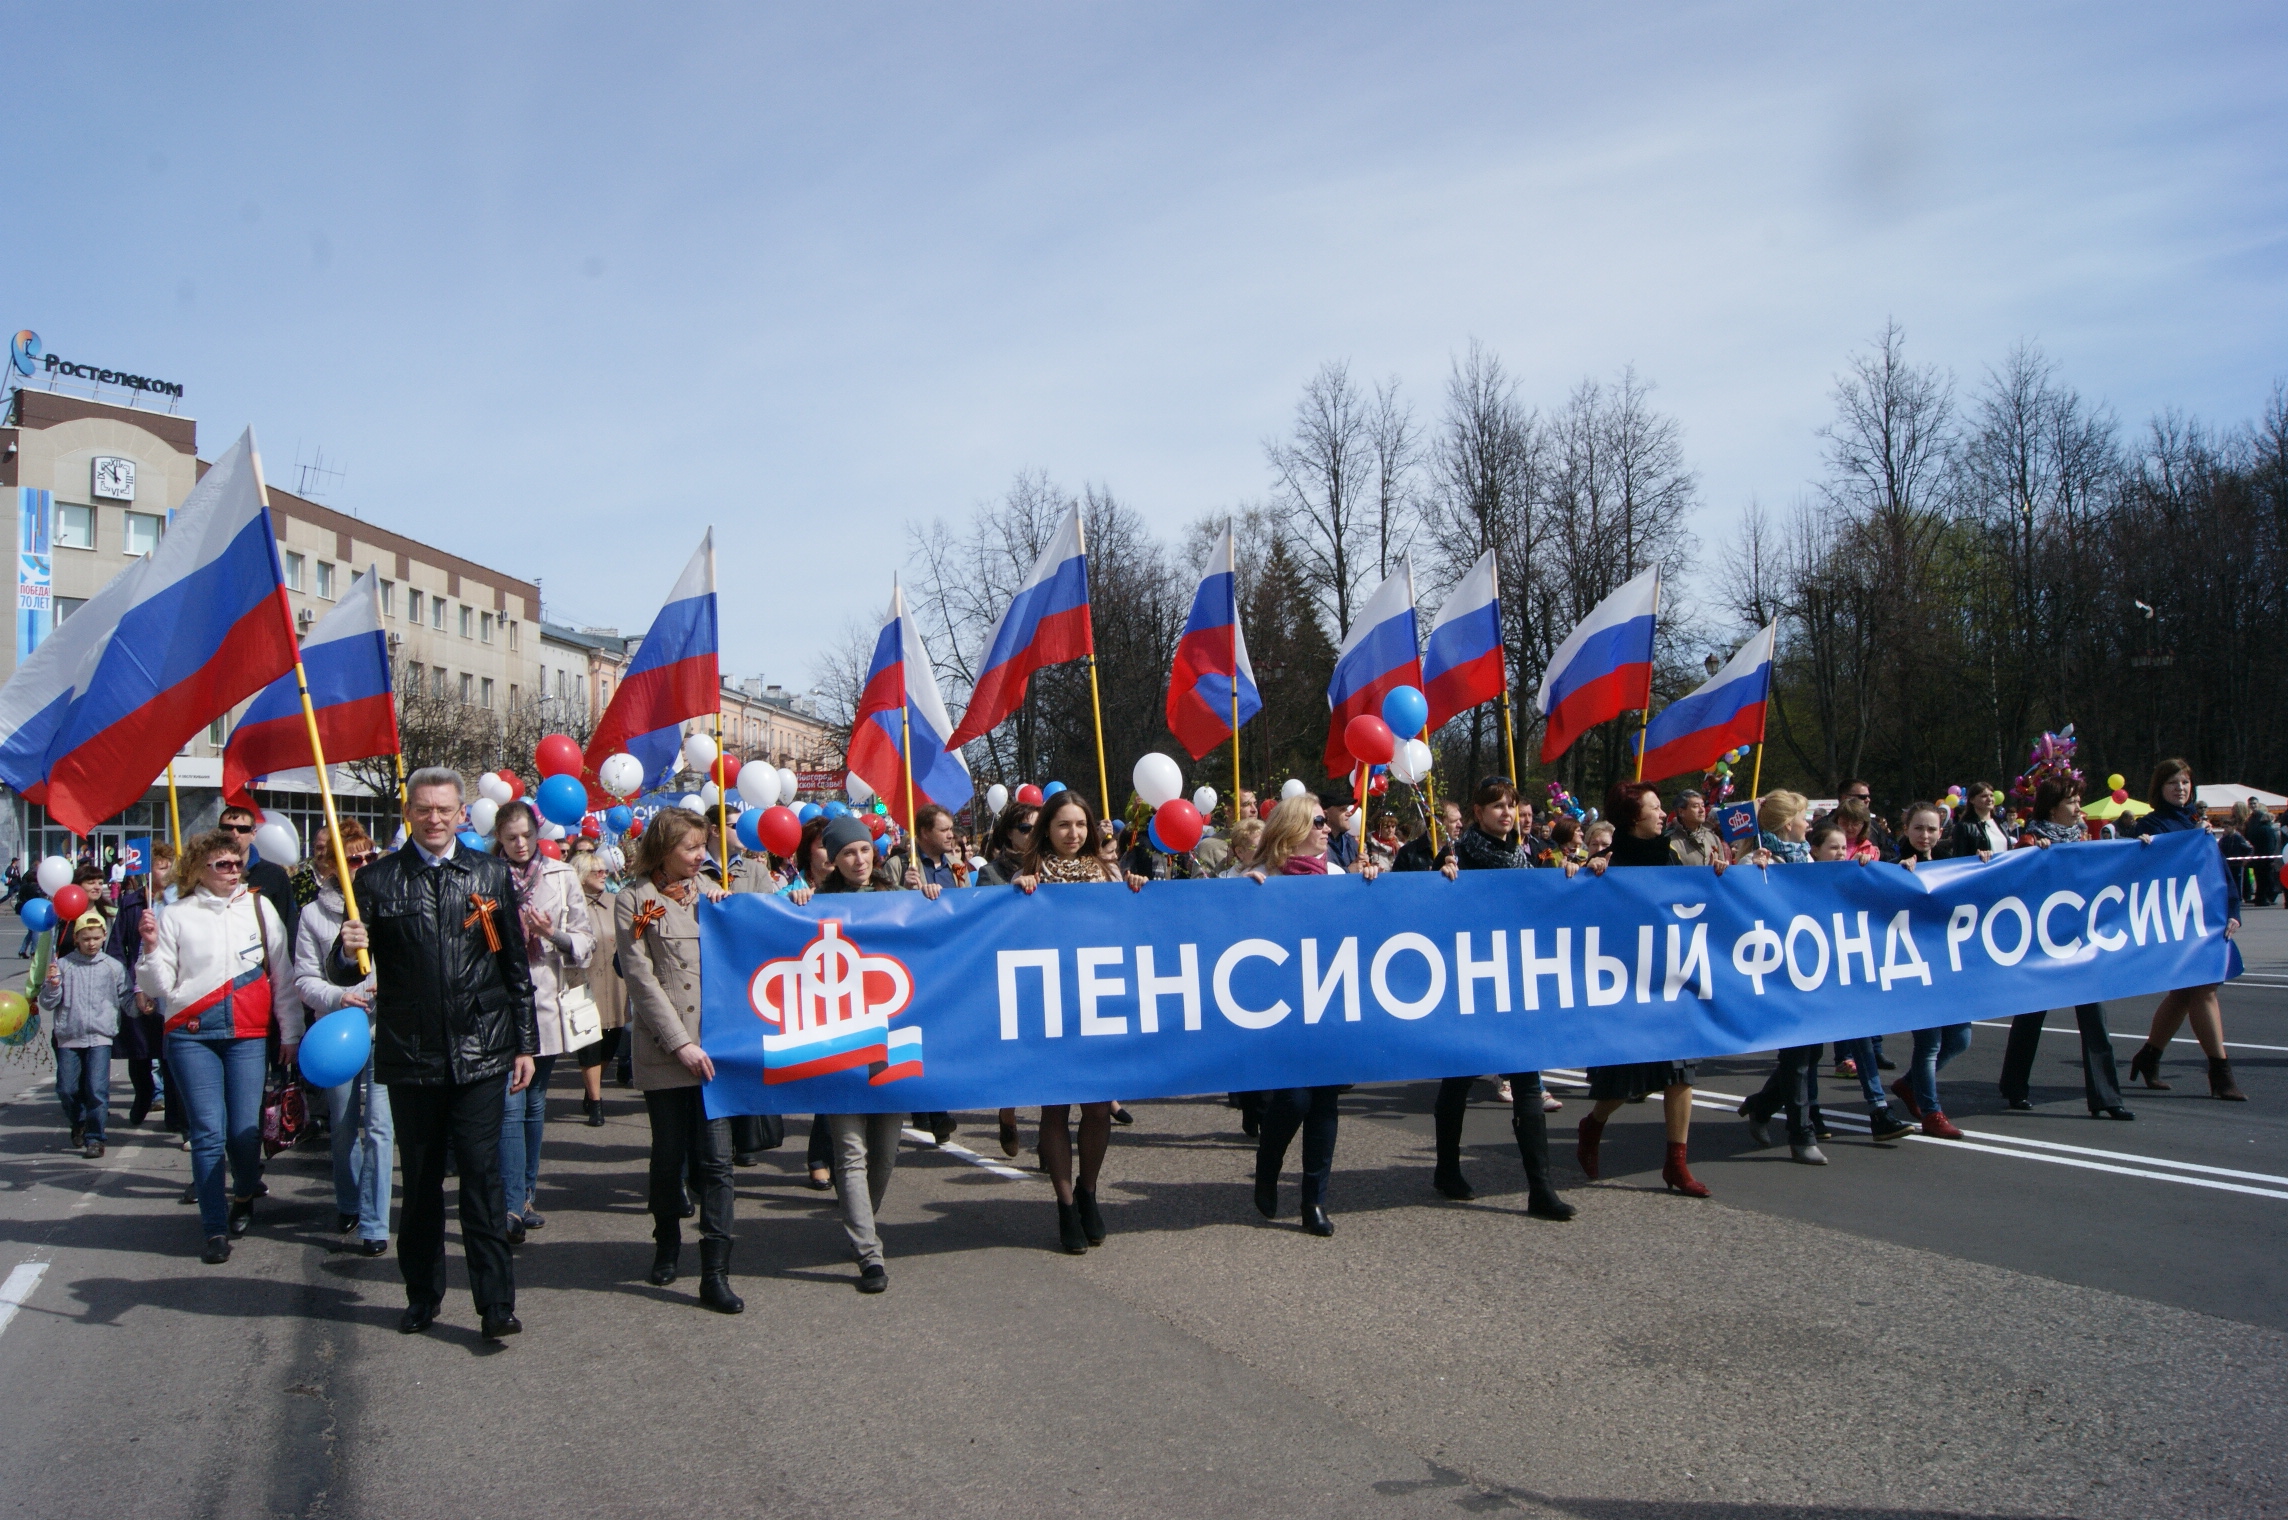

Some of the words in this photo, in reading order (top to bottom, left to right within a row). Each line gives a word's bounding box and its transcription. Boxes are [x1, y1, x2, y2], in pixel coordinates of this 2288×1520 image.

[45, 353, 183, 397] Ростелеком
[20, 595, 32, 608] 70
[33, 596, 50, 609] ЛЕТ
[997, 904, 1712, 1040] ПЕНСИОННЫЙ
[1732, 909, 1932, 992] ФОНД
[1947, 874, 2210, 972] РОССИИ
